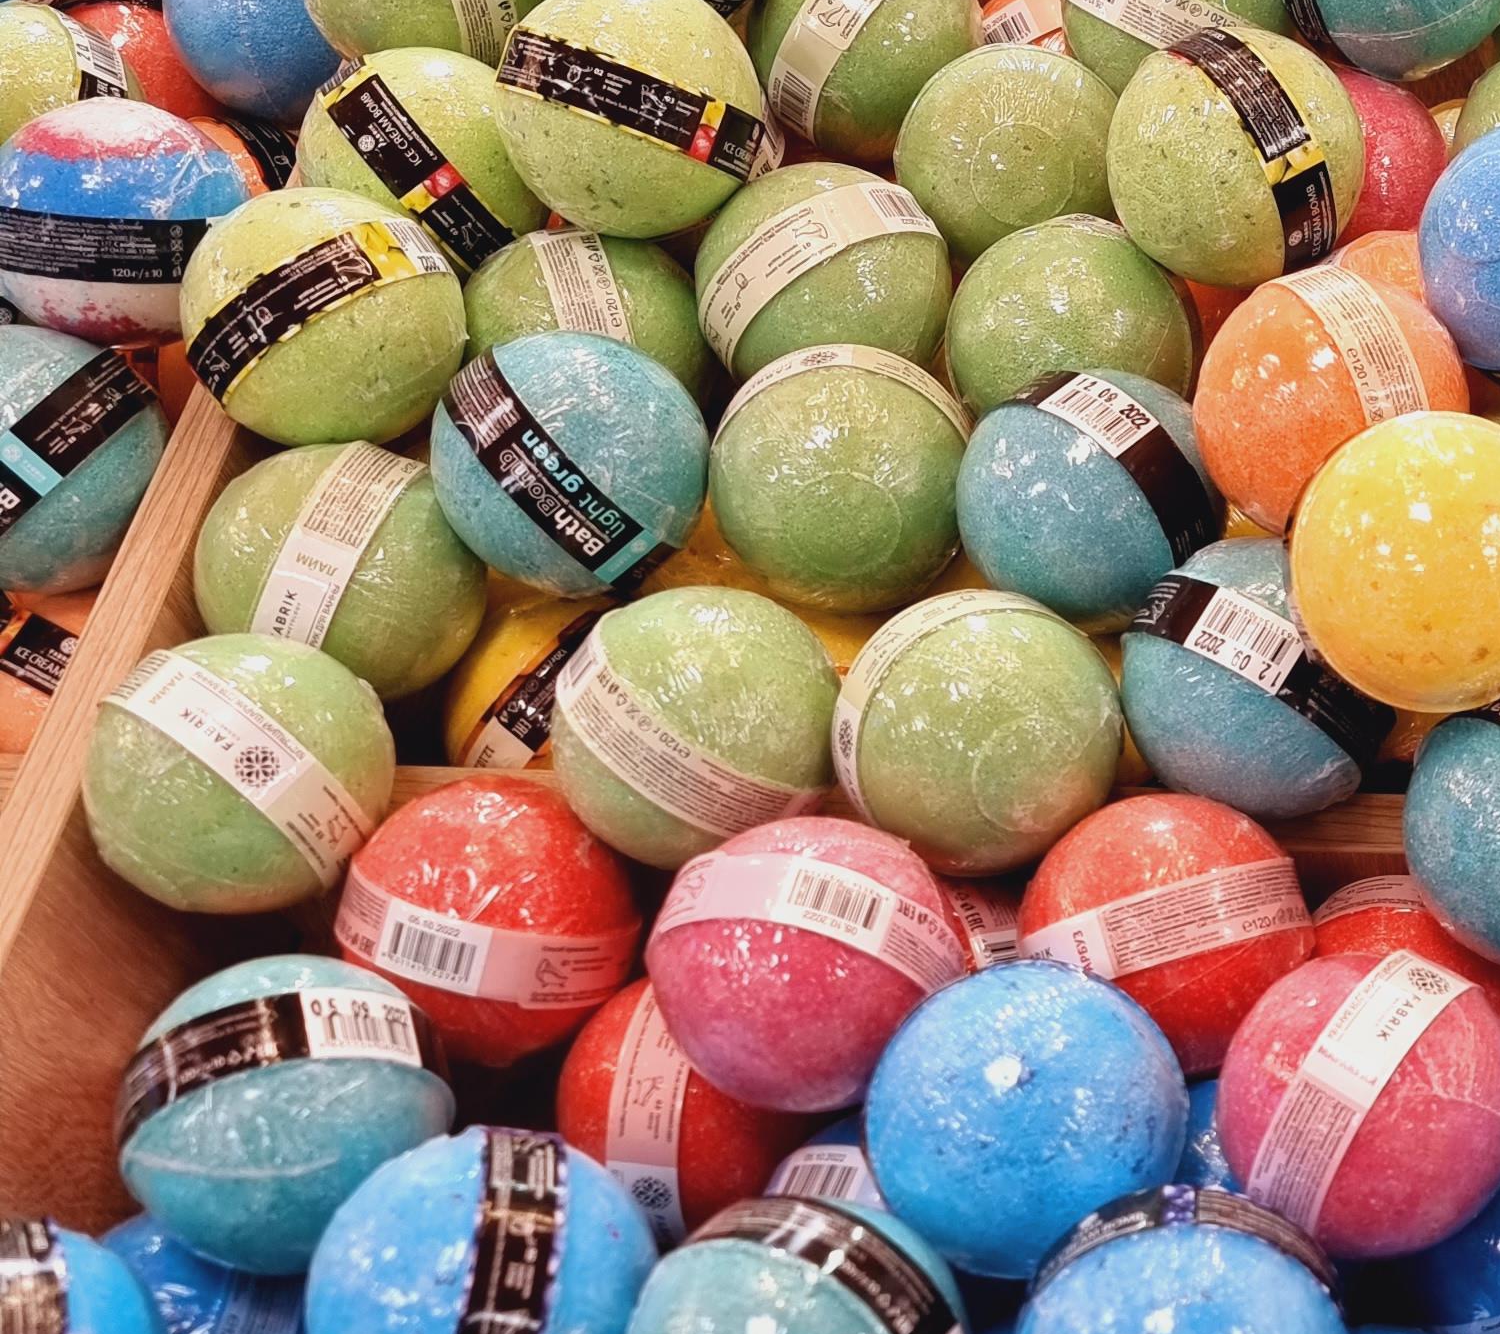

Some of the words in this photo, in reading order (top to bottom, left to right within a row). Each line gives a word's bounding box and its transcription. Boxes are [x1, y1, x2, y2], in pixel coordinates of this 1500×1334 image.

[358, 90, 384, 120] BOMB
[376, 113, 410, 152] CREAM
[522, 429, 596, 499] green
[574, 484, 629, 544] light
[177, 702, 237, 757] FABRIK
